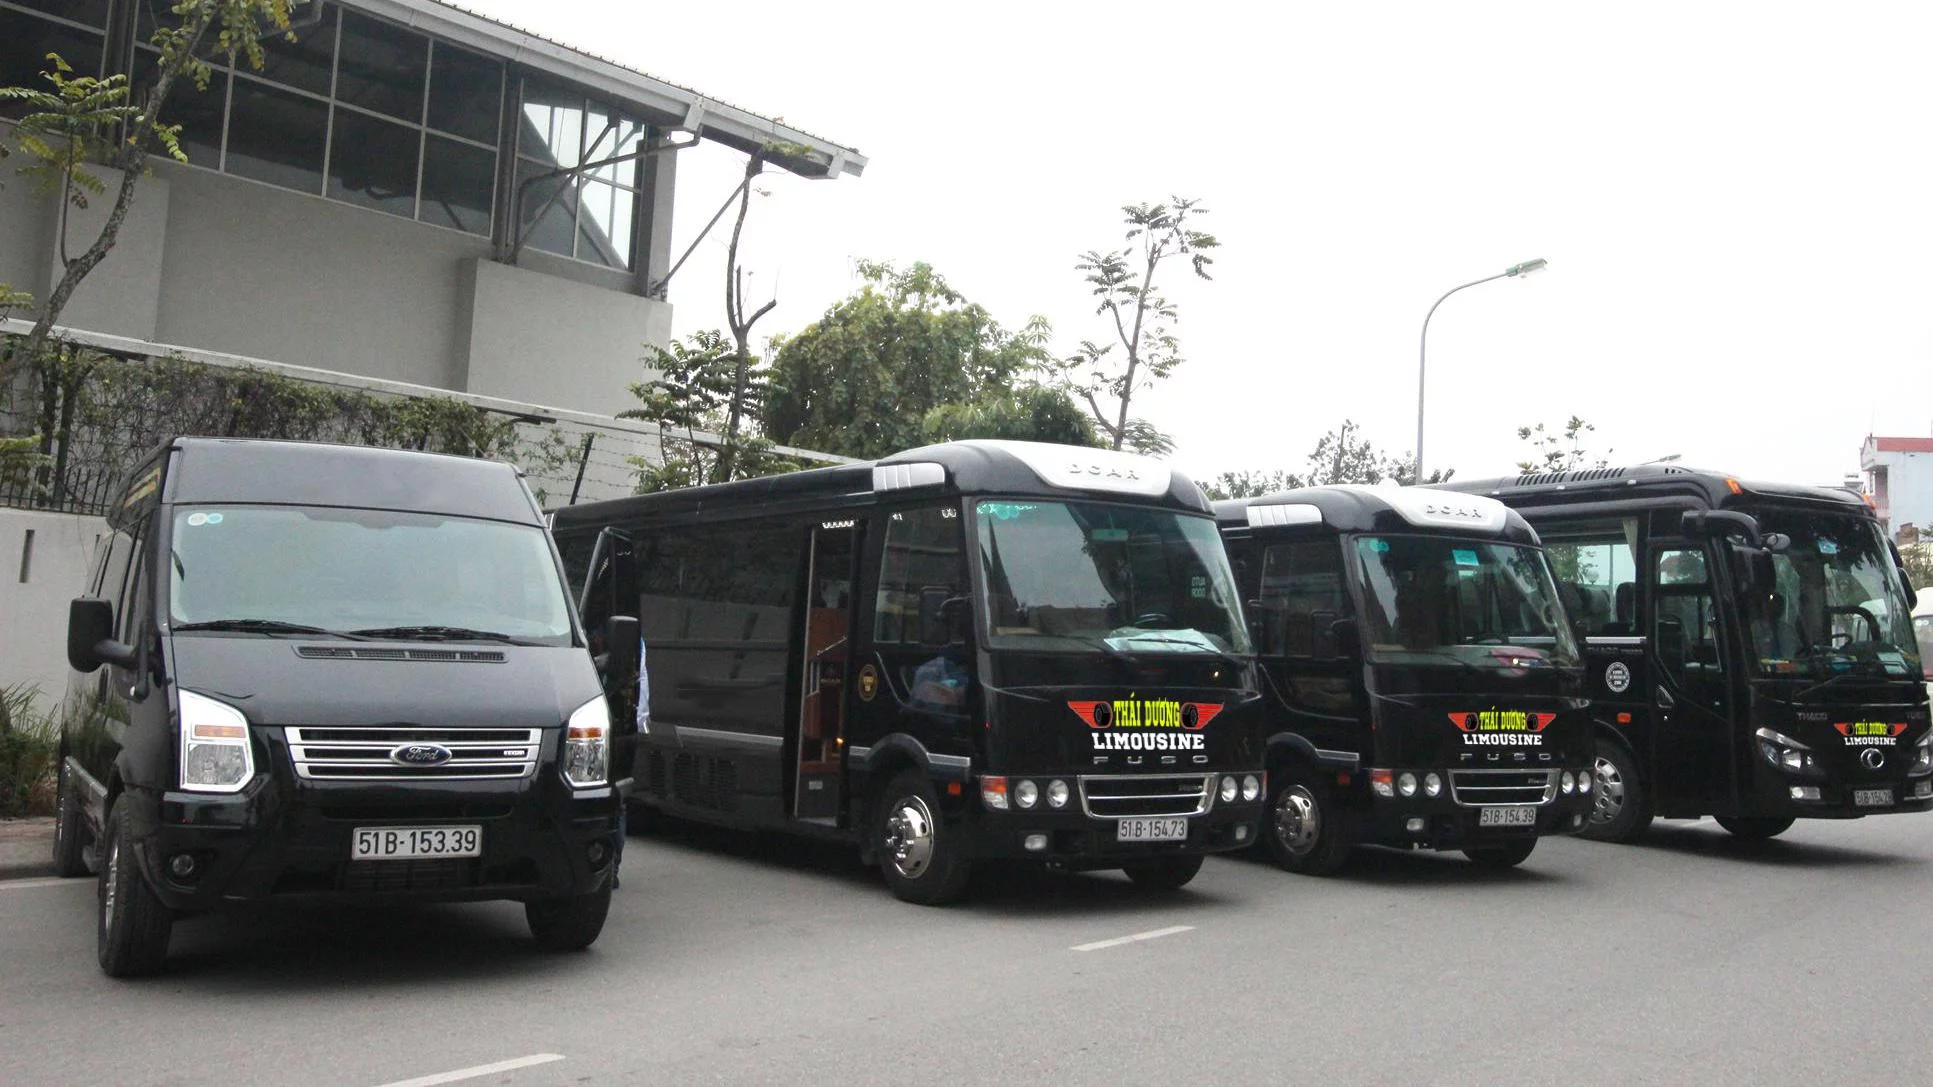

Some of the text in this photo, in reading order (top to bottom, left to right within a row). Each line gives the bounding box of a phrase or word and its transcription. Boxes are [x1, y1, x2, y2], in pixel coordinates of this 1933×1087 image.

[1113, 691, 1141, 727] THÁI
[1091, 732, 1205, 750] LIMOUSINE
[1463, 733, 1543, 745] LIMOUSINE
[1844, 736, 1897, 746] LIMOUSINE
[406, 746, 439, 760] Ford
[1460, 753, 1551, 761] FUSO
[1093, 755, 1209, 764] FUSO
